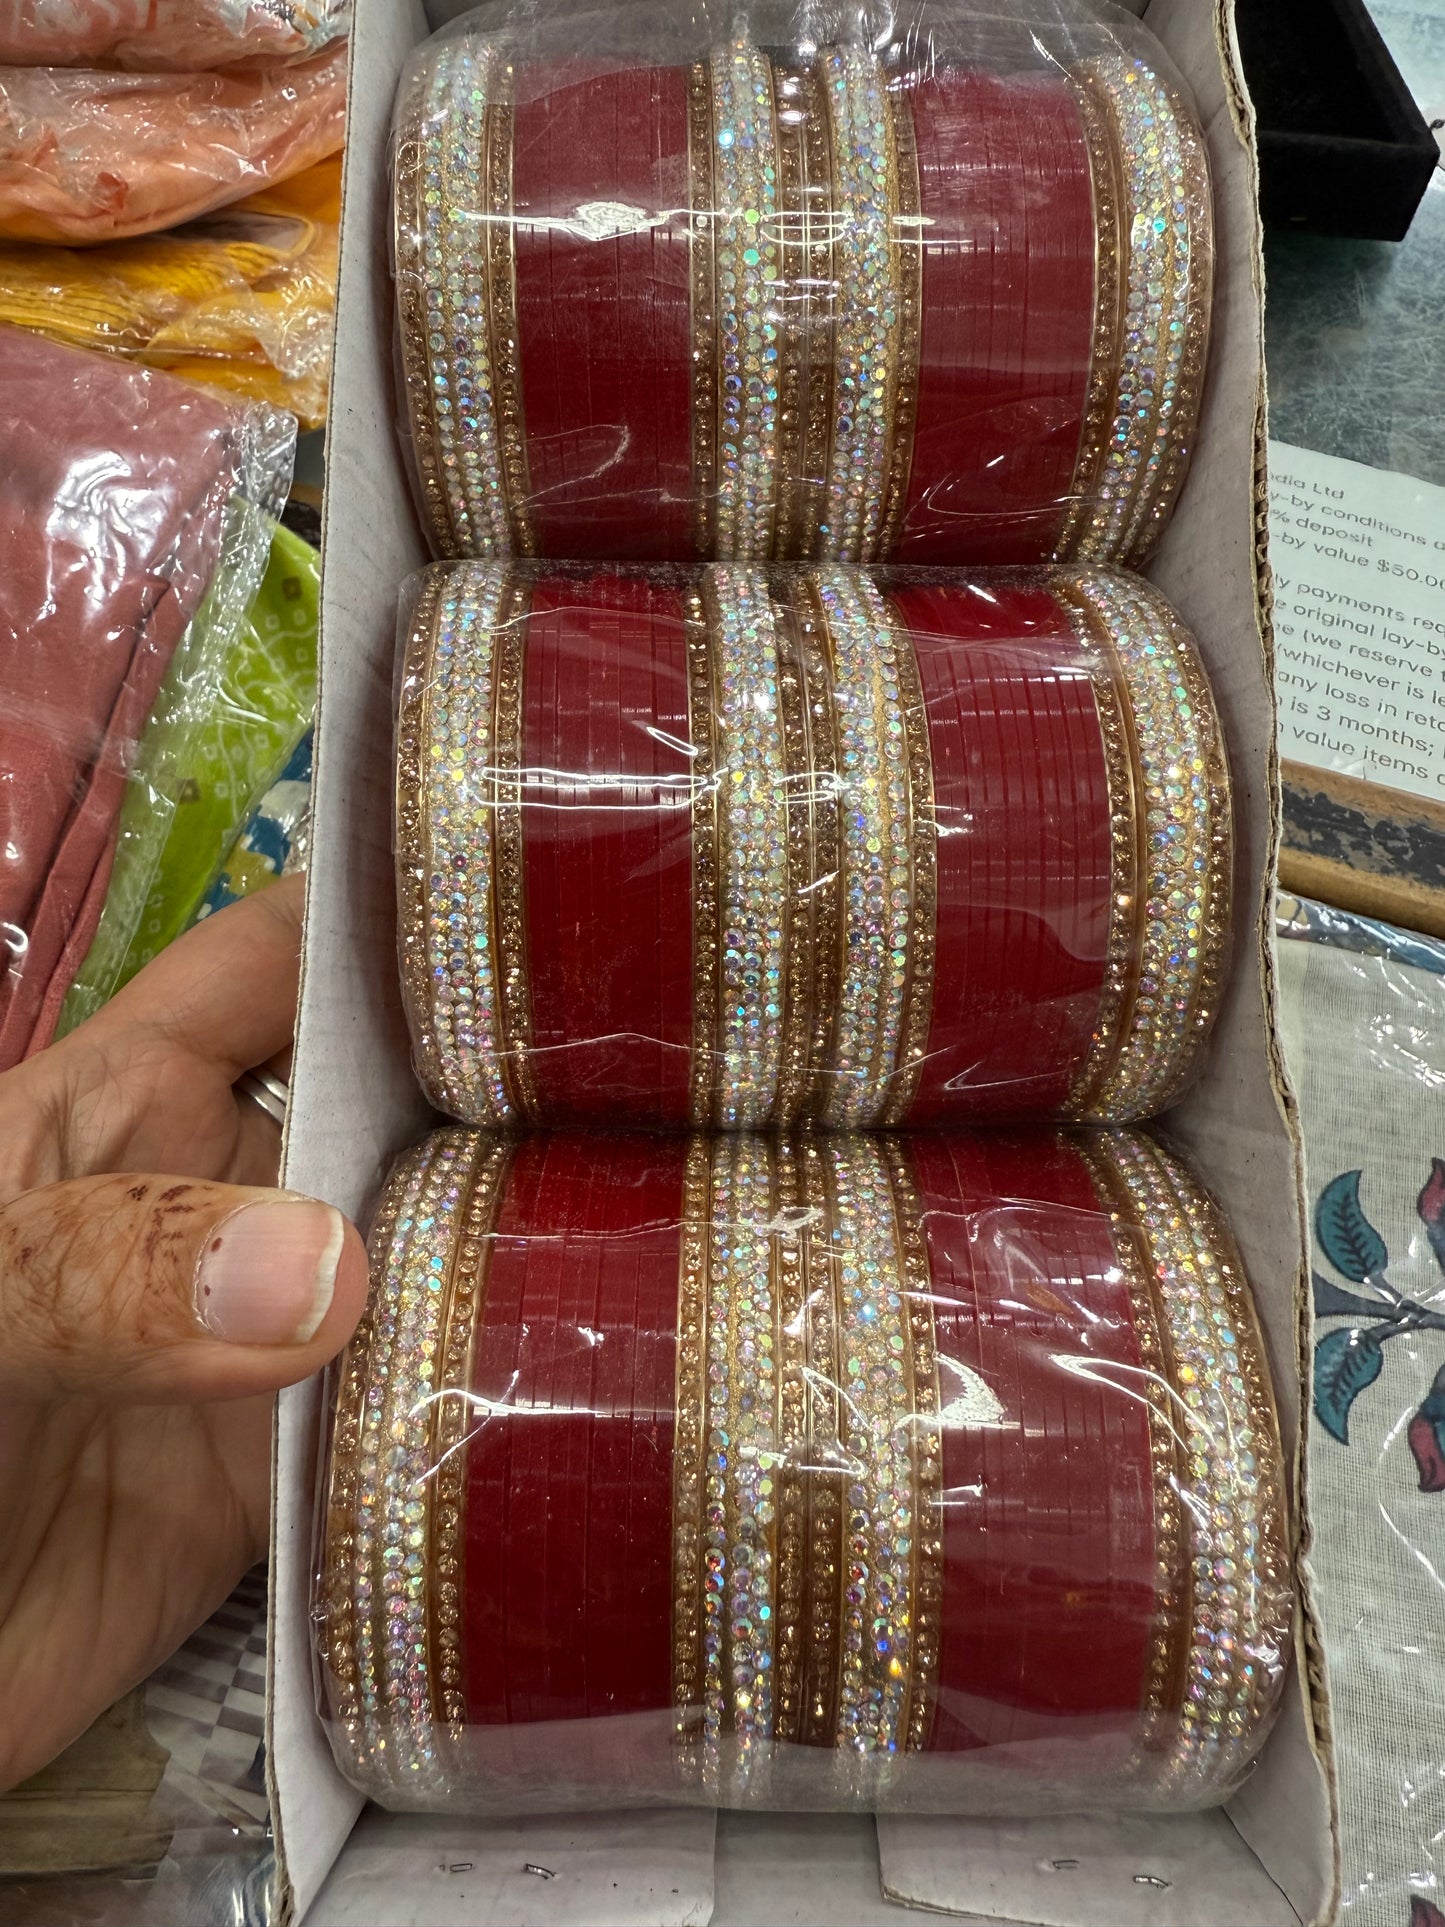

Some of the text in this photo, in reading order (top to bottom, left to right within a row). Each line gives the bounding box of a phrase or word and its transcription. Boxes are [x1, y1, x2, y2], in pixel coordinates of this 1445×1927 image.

[1313, 483, 1344, 499] Ltd
[1296, 517, 1373, 547] deposit
[1321, 505, 1426, 545] conditions
[1314, 543, 1369, 566] value
[1293, 605, 1375, 636] original
[1297, 583, 1405, 621] payments
[1277, 643, 1400, 691] (whichever
[1407, 682, 1424, 699] is
[1303, 629, 1342, 650] (we
[1349, 644, 1433, 677] reserve
[1278, 671, 1317, 692] any
[1326, 682, 1369, 708] loss
[1377, 698, 1397, 717] in
[1290, 696, 1309, 714] is
[1317, 705, 1331, 721] 3
[1338, 714, 1434, 757] months;
[1293, 726, 1355, 756] value
[1362, 746, 1428, 779] items
